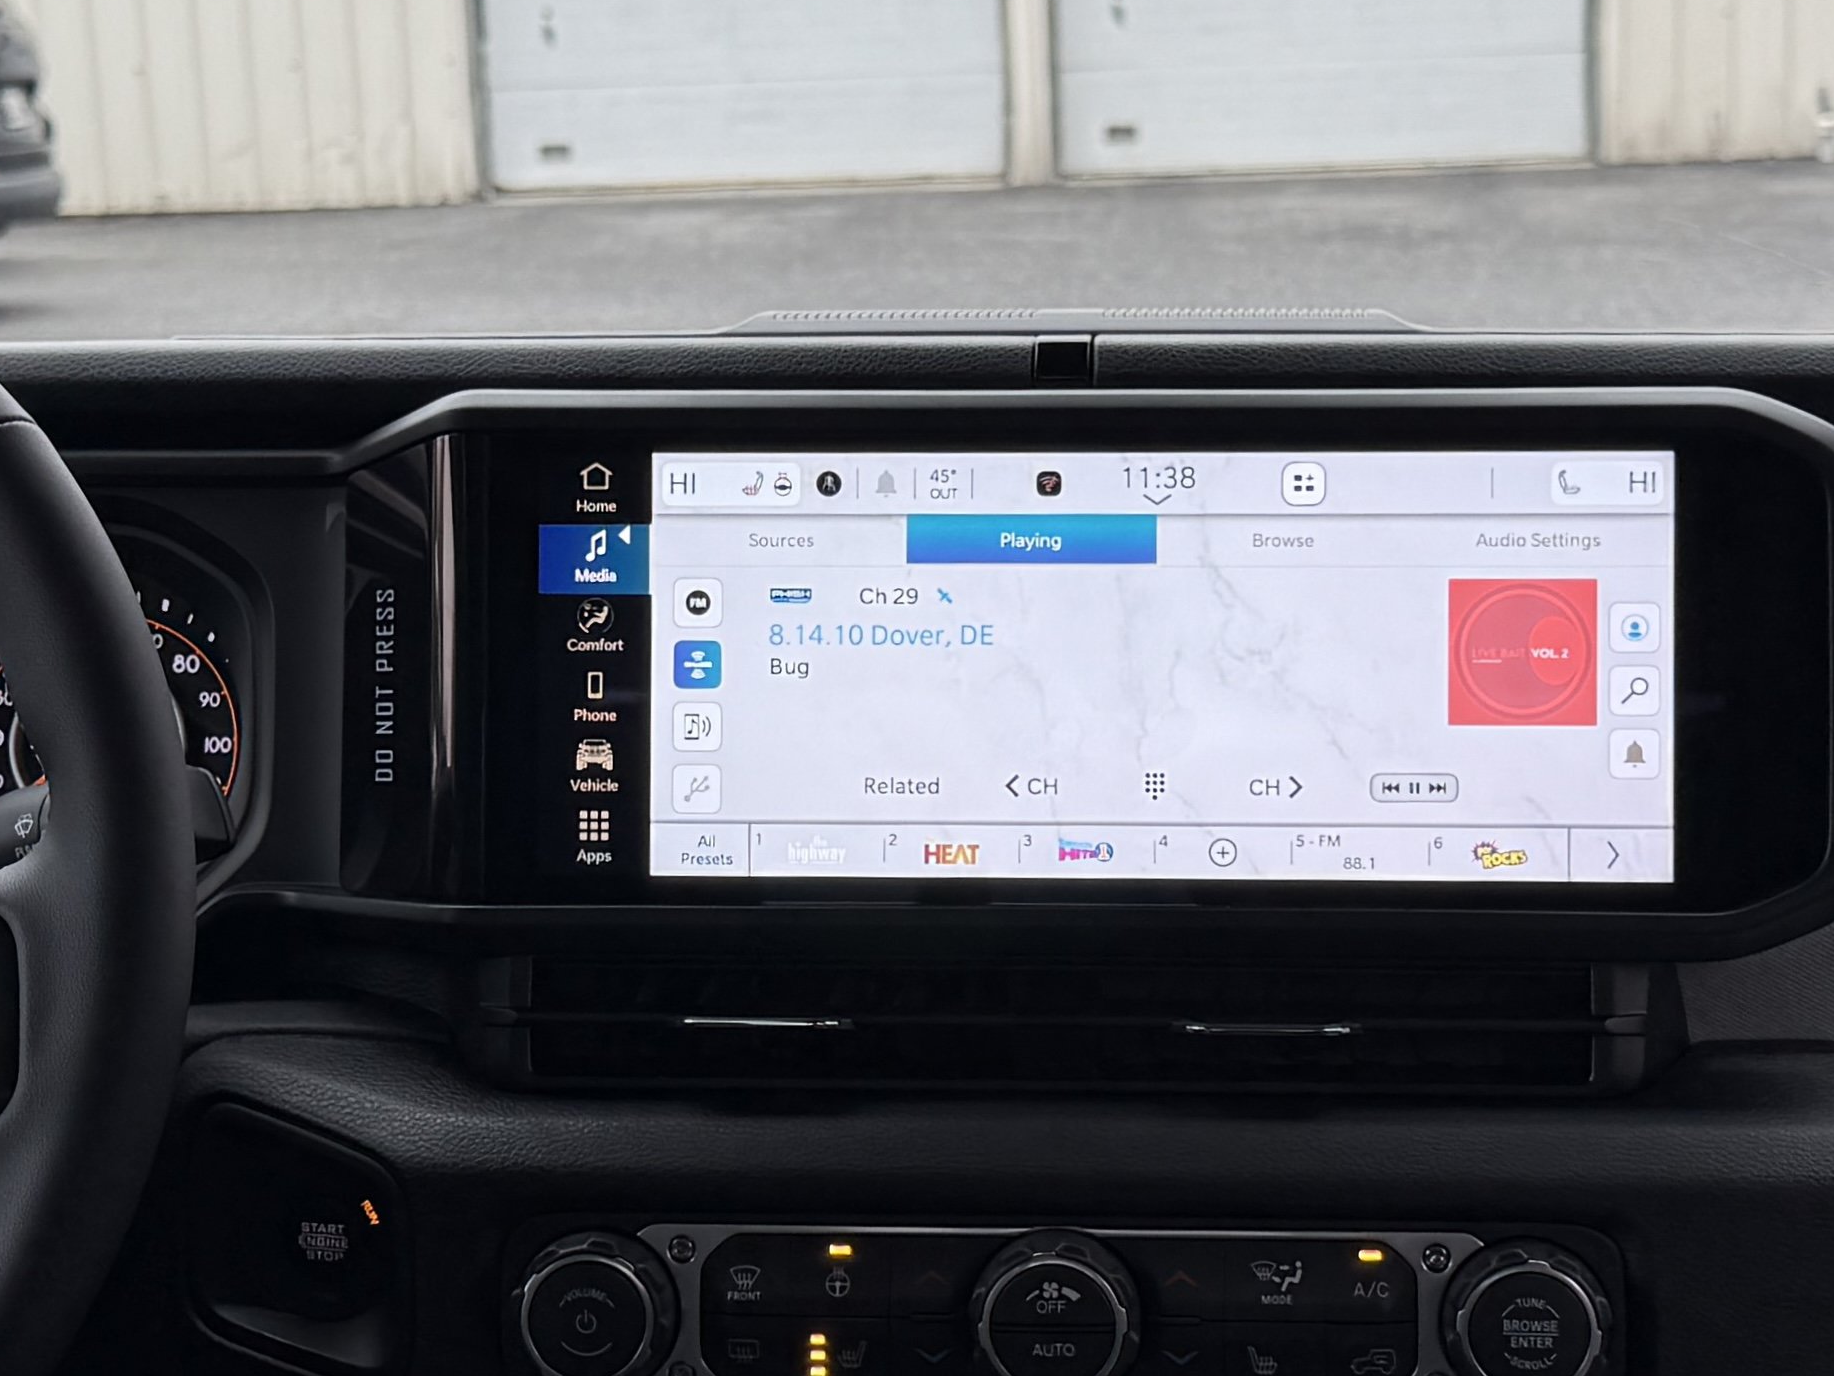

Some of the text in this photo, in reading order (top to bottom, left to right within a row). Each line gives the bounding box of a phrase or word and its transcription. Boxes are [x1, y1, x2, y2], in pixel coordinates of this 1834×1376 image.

[669, 472, 697, 496] HI
[929, 468, 957, 484] 45°
[1122, 466, 1196, 491] 11:38
[1628, 471, 1657, 494] HI
[929, 487, 958, 501] OUT
[576, 499, 617, 513] Home
[748, 532, 815, 549] Sources
[999, 532, 1063, 553] Playing
[1252, 532, 1315, 550] Browse
[1476, 532, 1602, 552] Audio Settings
[574, 568, 617, 584] Media
[859, 587, 919, 605] Ch 29
[768, 623, 995, 649] 8.14.10 Dover, DE
[566, 638, 624, 653] Comfort
[171, 653, 201, 675] 80
[769, 657, 810, 679] Bug
[374, 587, 395, 784] DO NOT PRESS
[199, 690, 221, 709] 90
[574, 709, 617, 723] Phone
[203, 736, 233, 754] 100
[570, 778, 619, 793] Vehicle
[864, 777, 941, 795] Related
[1027, 778, 1059, 796] CH
[1249, 778, 1281, 797] CH
[698, 834, 716, 848] All
[888, 833, 898, 846] 2
[1023, 833, 1033, 847] 3
[1319, 834, 1342, 849] FM
[1433, 836, 1444, 850] 6
[576, 850, 612, 866] Apps
[681, 852, 735, 866] Presets
[924, 844, 980, 865] HEAT
[1342, 857, 1376, 871] 88.1
[300, 1221, 347, 1235] START
[305, 1249, 345, 1263] STOP
[726, 1290, 763, 1303] FRONT
[1352, 1280, 1390, 1300] A/C
[1035, 1299, 1067, 1315] OFF
[1260, 1293, 1294, 1307] MODE
[1514, 1297, 1548, 1311] TUNE
[1501, 1318, 1559, 1333] BROWSE
[1031, 1342, 1076, 1358] AUTO
[1509, 1335, 1554, 1350] ENTER
[1508, 1355, 1553, 1371] SCROLL
